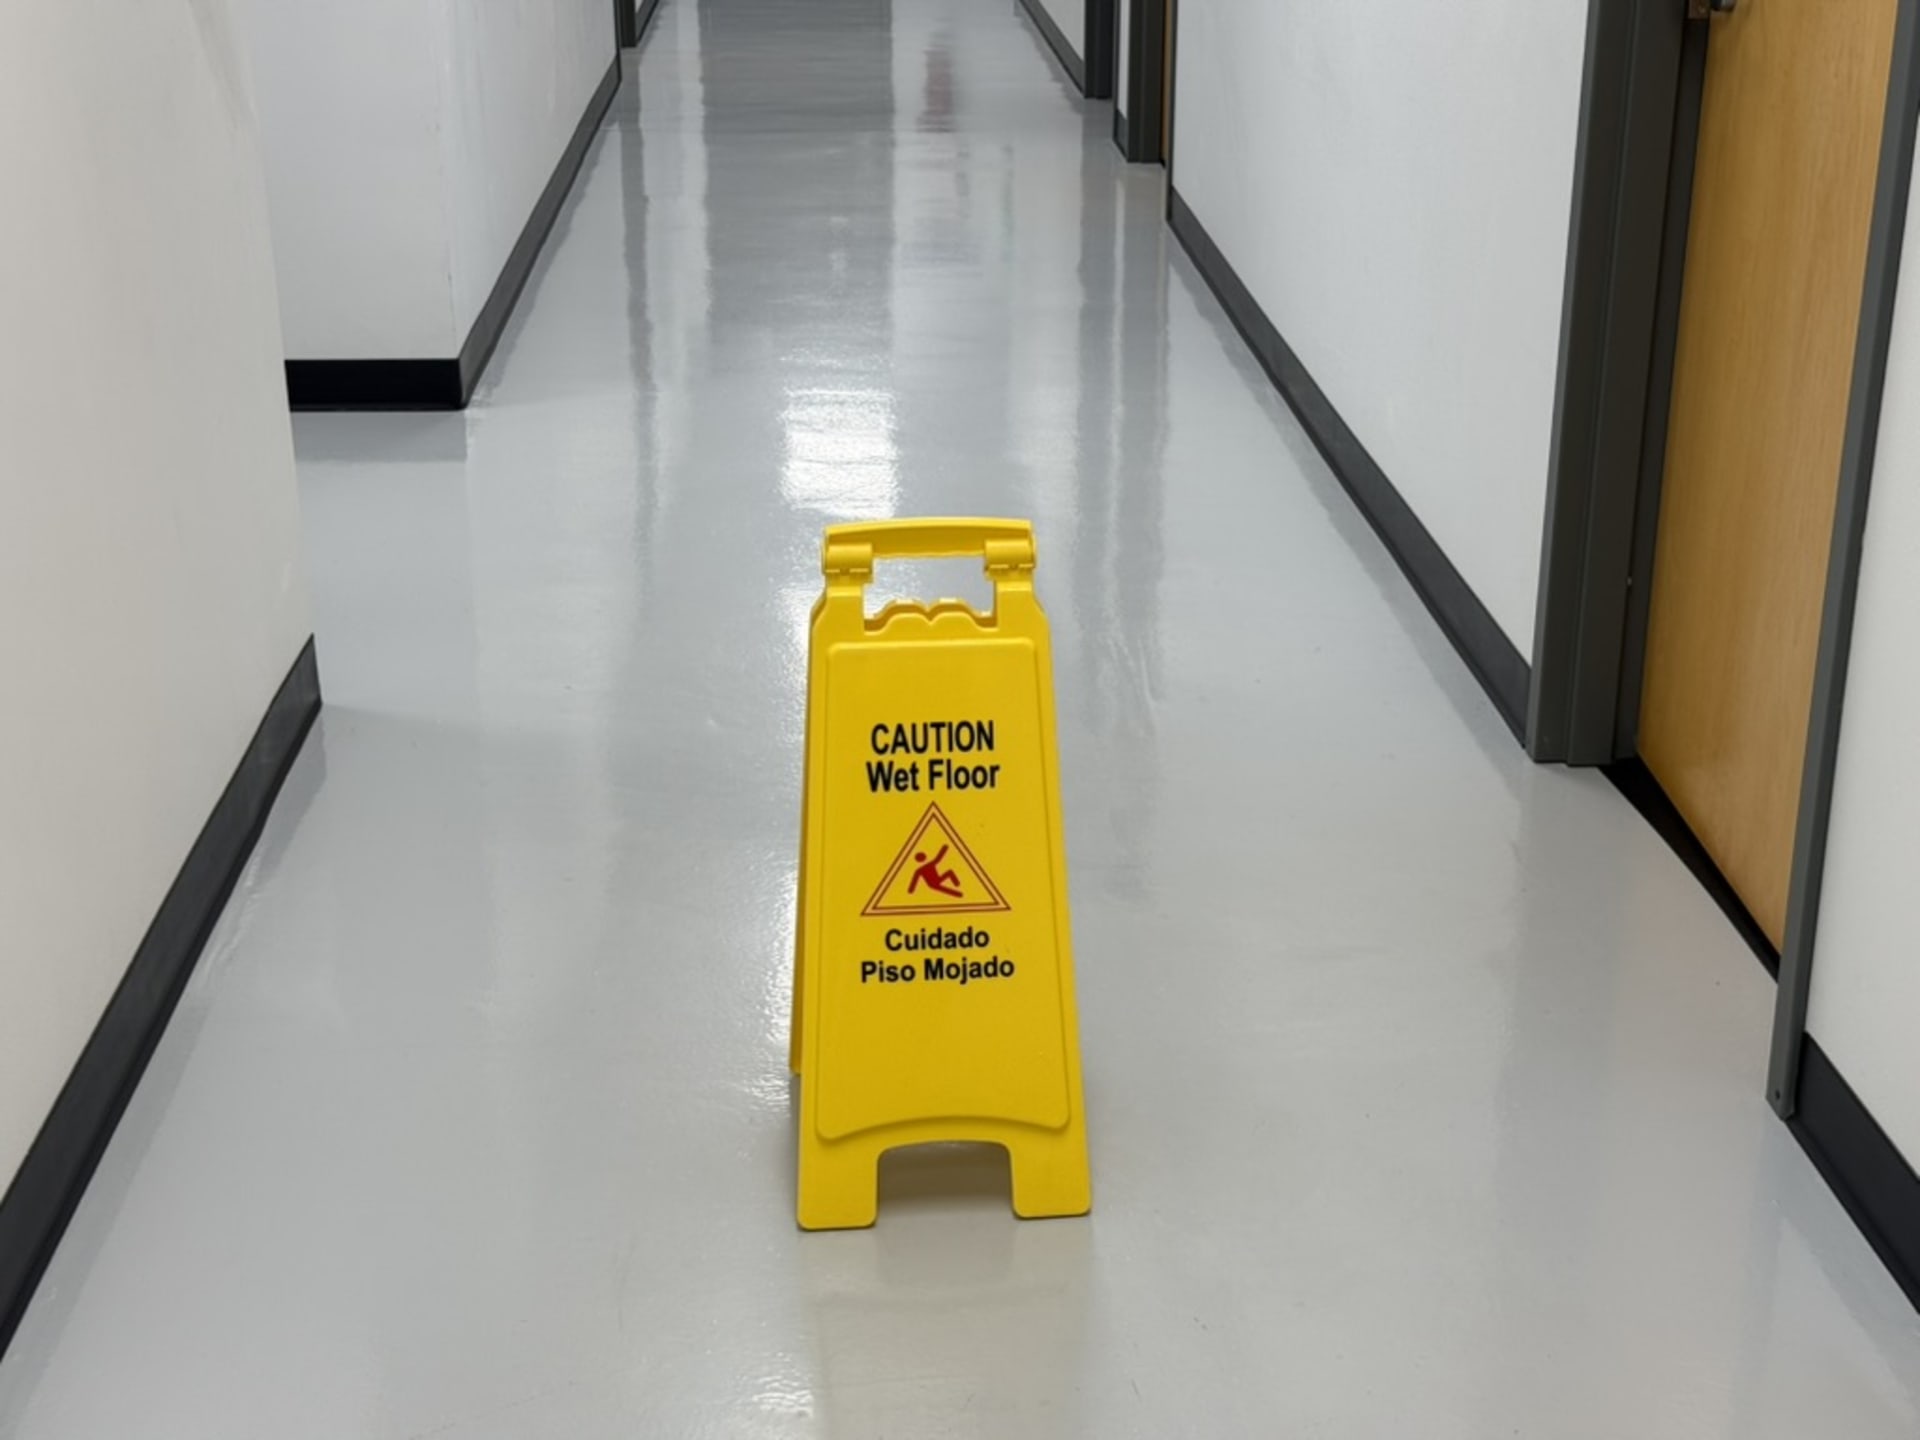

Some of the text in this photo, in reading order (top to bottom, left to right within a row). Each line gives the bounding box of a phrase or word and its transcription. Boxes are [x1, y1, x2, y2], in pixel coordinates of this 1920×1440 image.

[870, 719, 995, 756] CAUTION
[865, 758, 1001, 793] Wet Floor
[884, 925, 990, 952] Cuidado
[860, 955, 1015, 986] Piso Mojado
